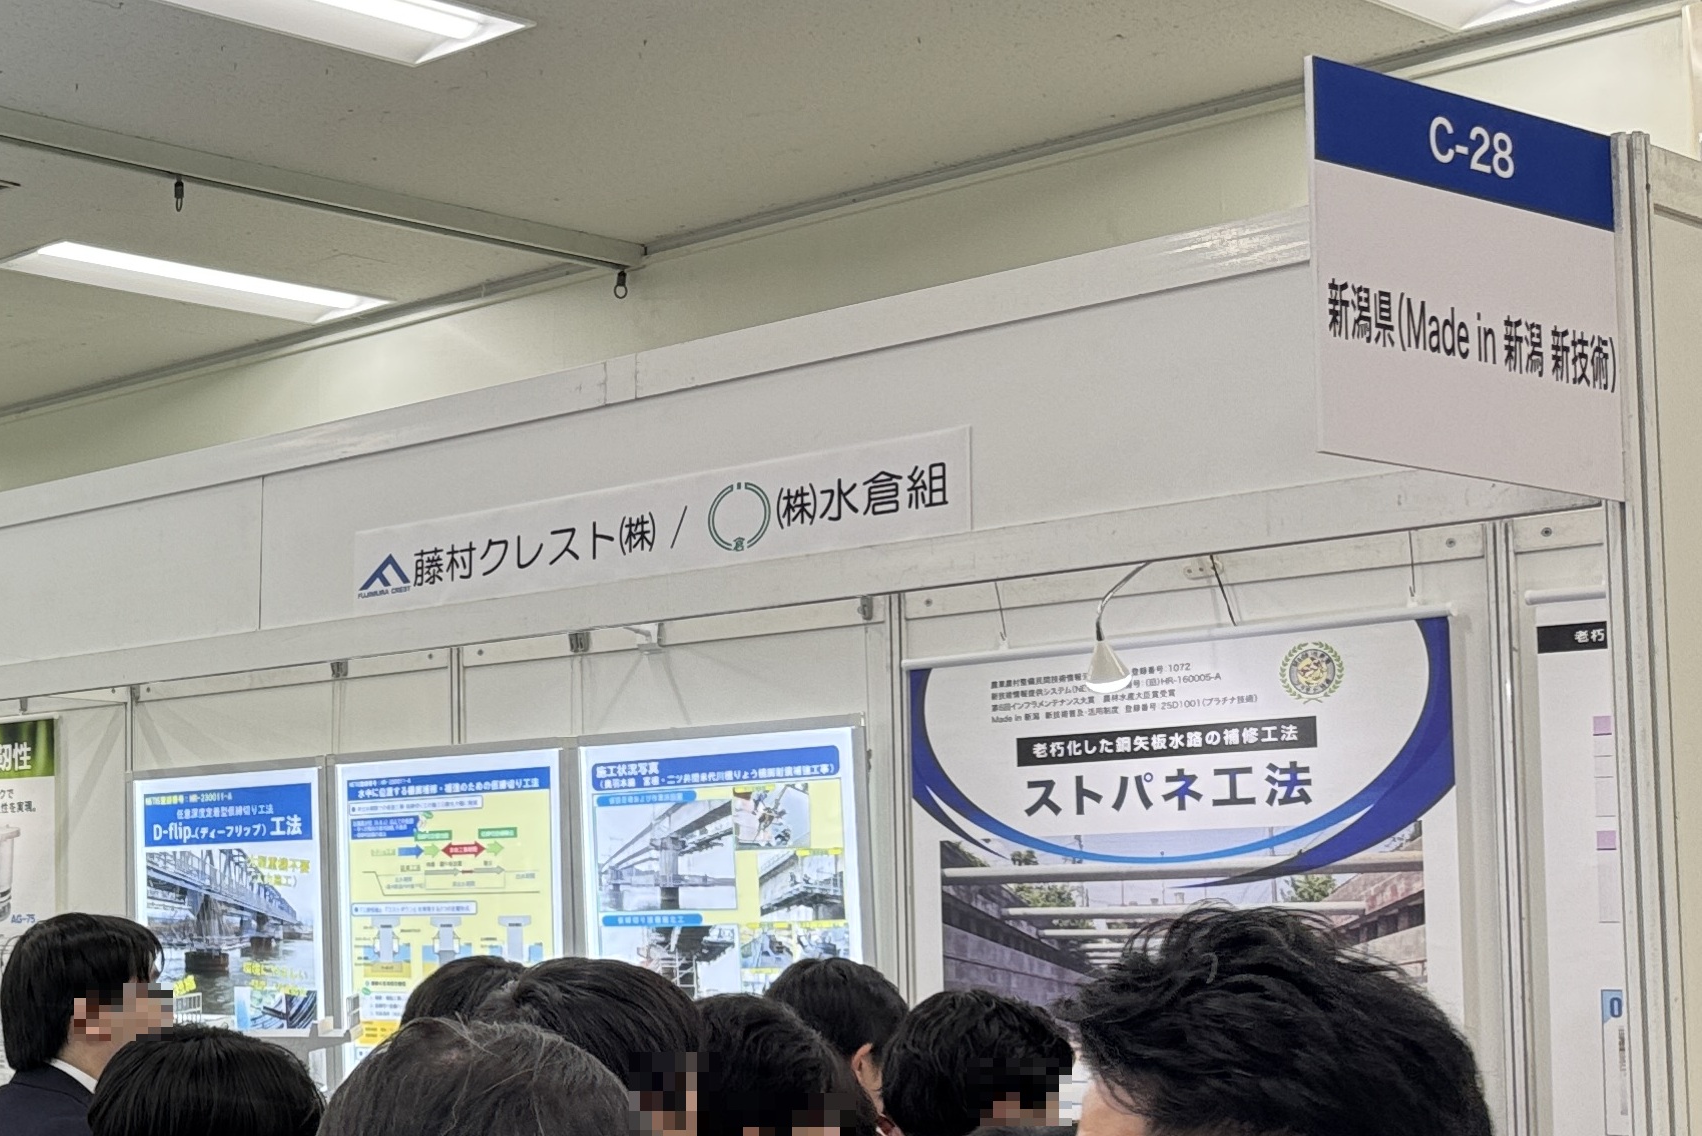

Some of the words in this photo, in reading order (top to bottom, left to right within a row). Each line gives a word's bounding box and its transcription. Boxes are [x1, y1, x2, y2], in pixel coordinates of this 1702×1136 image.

[1429, 116, 1515, 179] C-28
[1328, 278, 1470, 361] 新潟県(Made
[1477, 312, 1497, 365] in
[1503, 315, 1544, 378] 新潟
[1551, 325, 1617, 393] 新技術)
[1574, 628, 1606, 644] 老朽
[1032, 724, 1298, 760] 老朽化した鋼矢板水路の補修工法
[1024, 760, 1313, 816] ストパネ工法
